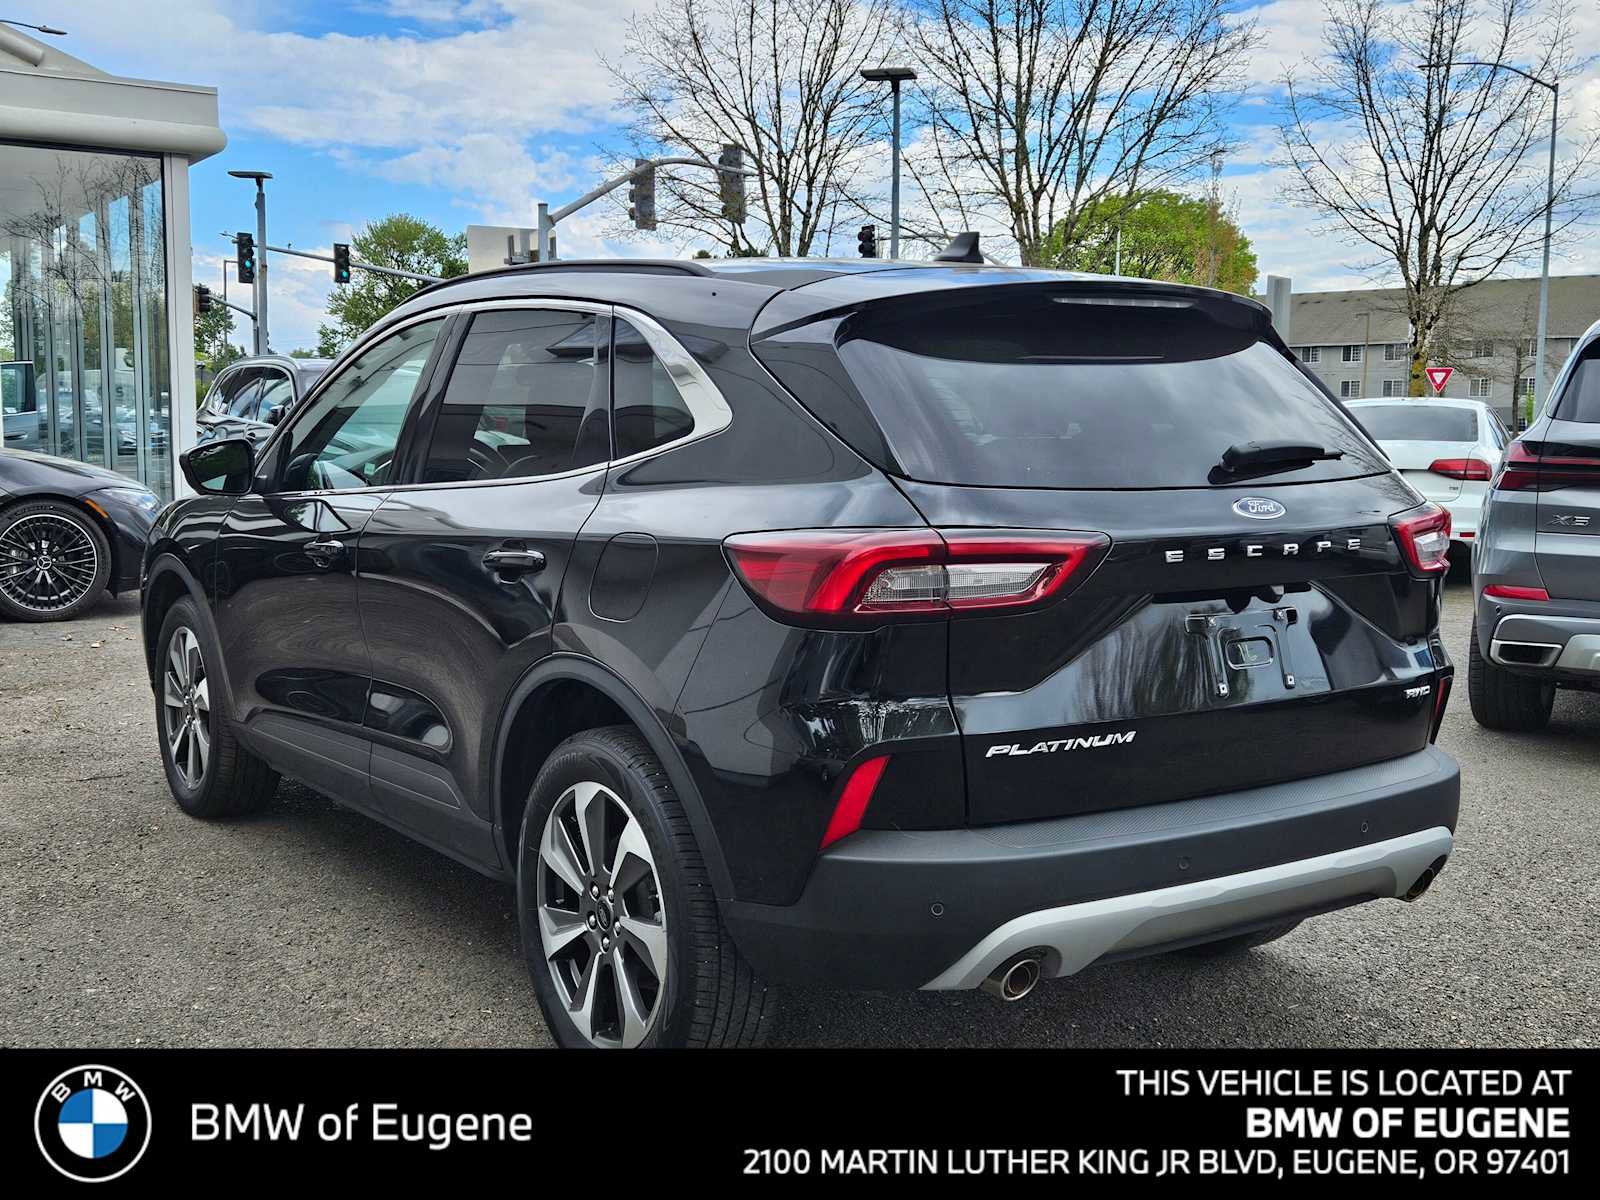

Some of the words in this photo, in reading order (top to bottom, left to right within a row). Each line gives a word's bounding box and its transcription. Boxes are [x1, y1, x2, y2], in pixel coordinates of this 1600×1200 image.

[1545, 514, 1591, 526] X5
[1165, 538, 1363, 564] ESCAPE
[985, 730, 1137, 758] PLATINUM
